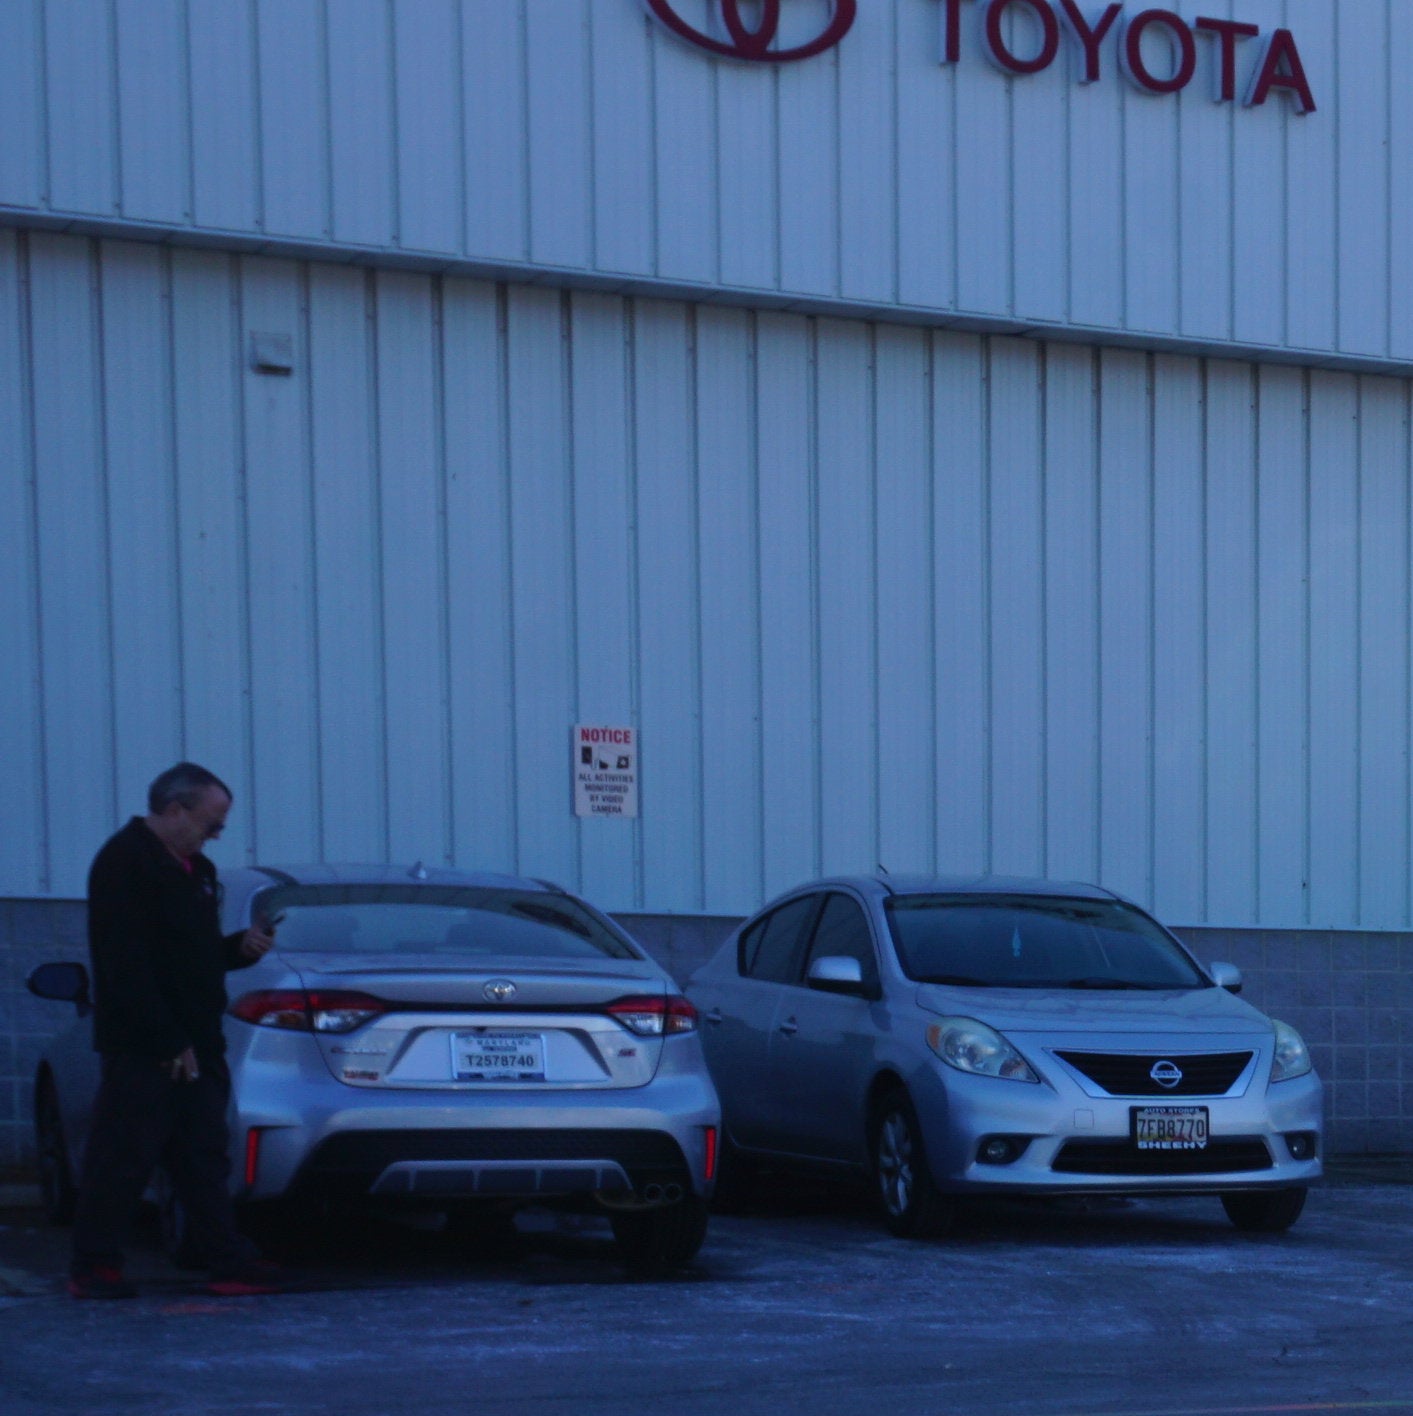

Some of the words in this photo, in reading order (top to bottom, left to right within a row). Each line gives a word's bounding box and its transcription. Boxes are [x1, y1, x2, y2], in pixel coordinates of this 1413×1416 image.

[581, 728, 631, 744] NOTICE
[591, 804, 622, 814] CAMERA
[465, 1054, 535, 1067] T2578740
[1138, 1119, 1205, 1138] 7FB8770
[1138, 1141, 1206, 1149] SHEEHY
